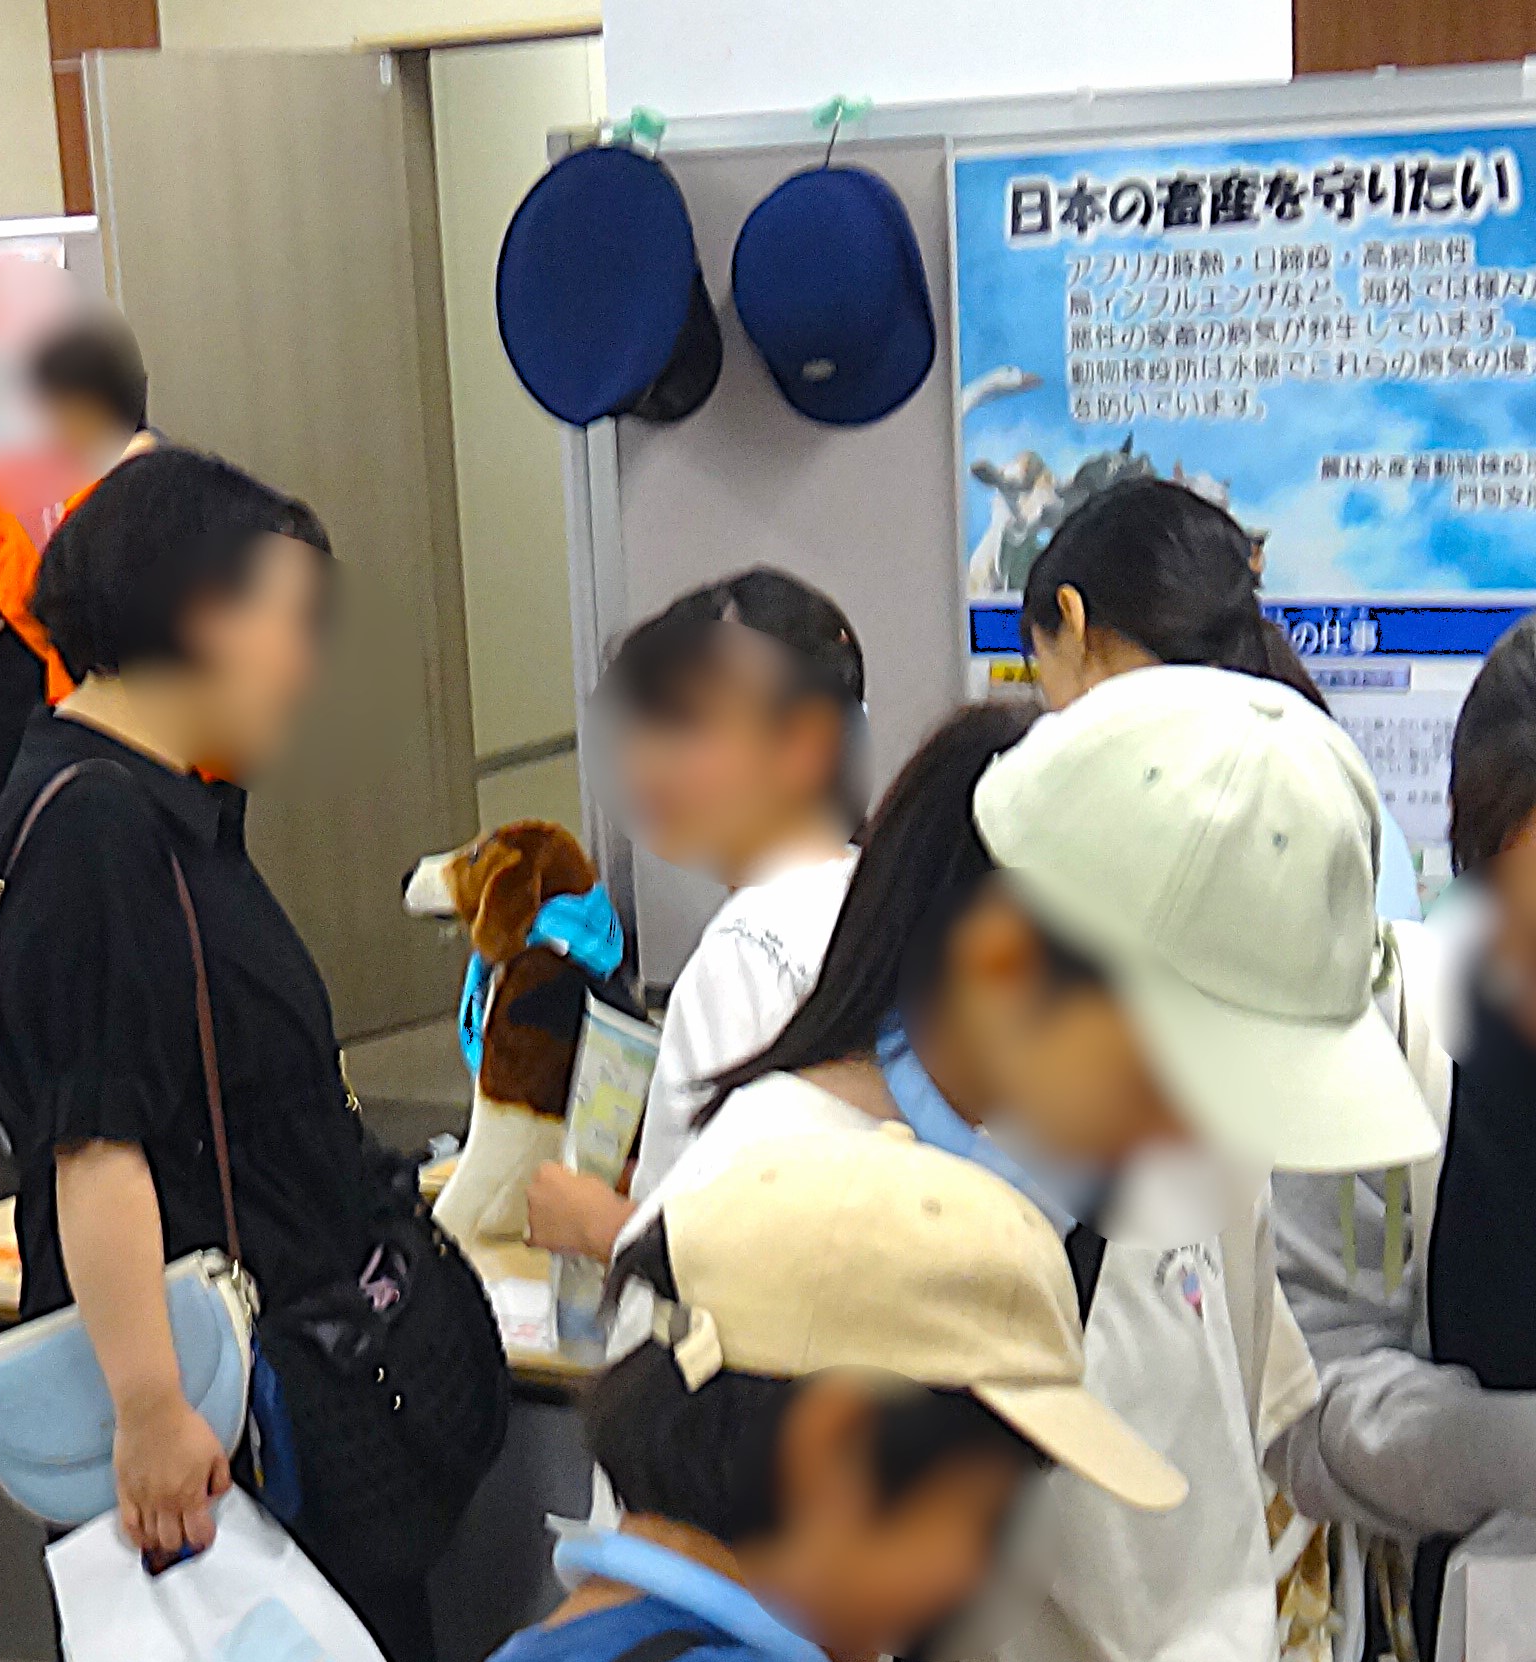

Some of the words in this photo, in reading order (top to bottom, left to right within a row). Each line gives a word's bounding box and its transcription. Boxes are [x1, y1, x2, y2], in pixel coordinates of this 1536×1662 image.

[1010, 157, 1511, 236] 日本の畜産を守りたい
[1278, 616, 1378, 656] の仕事
